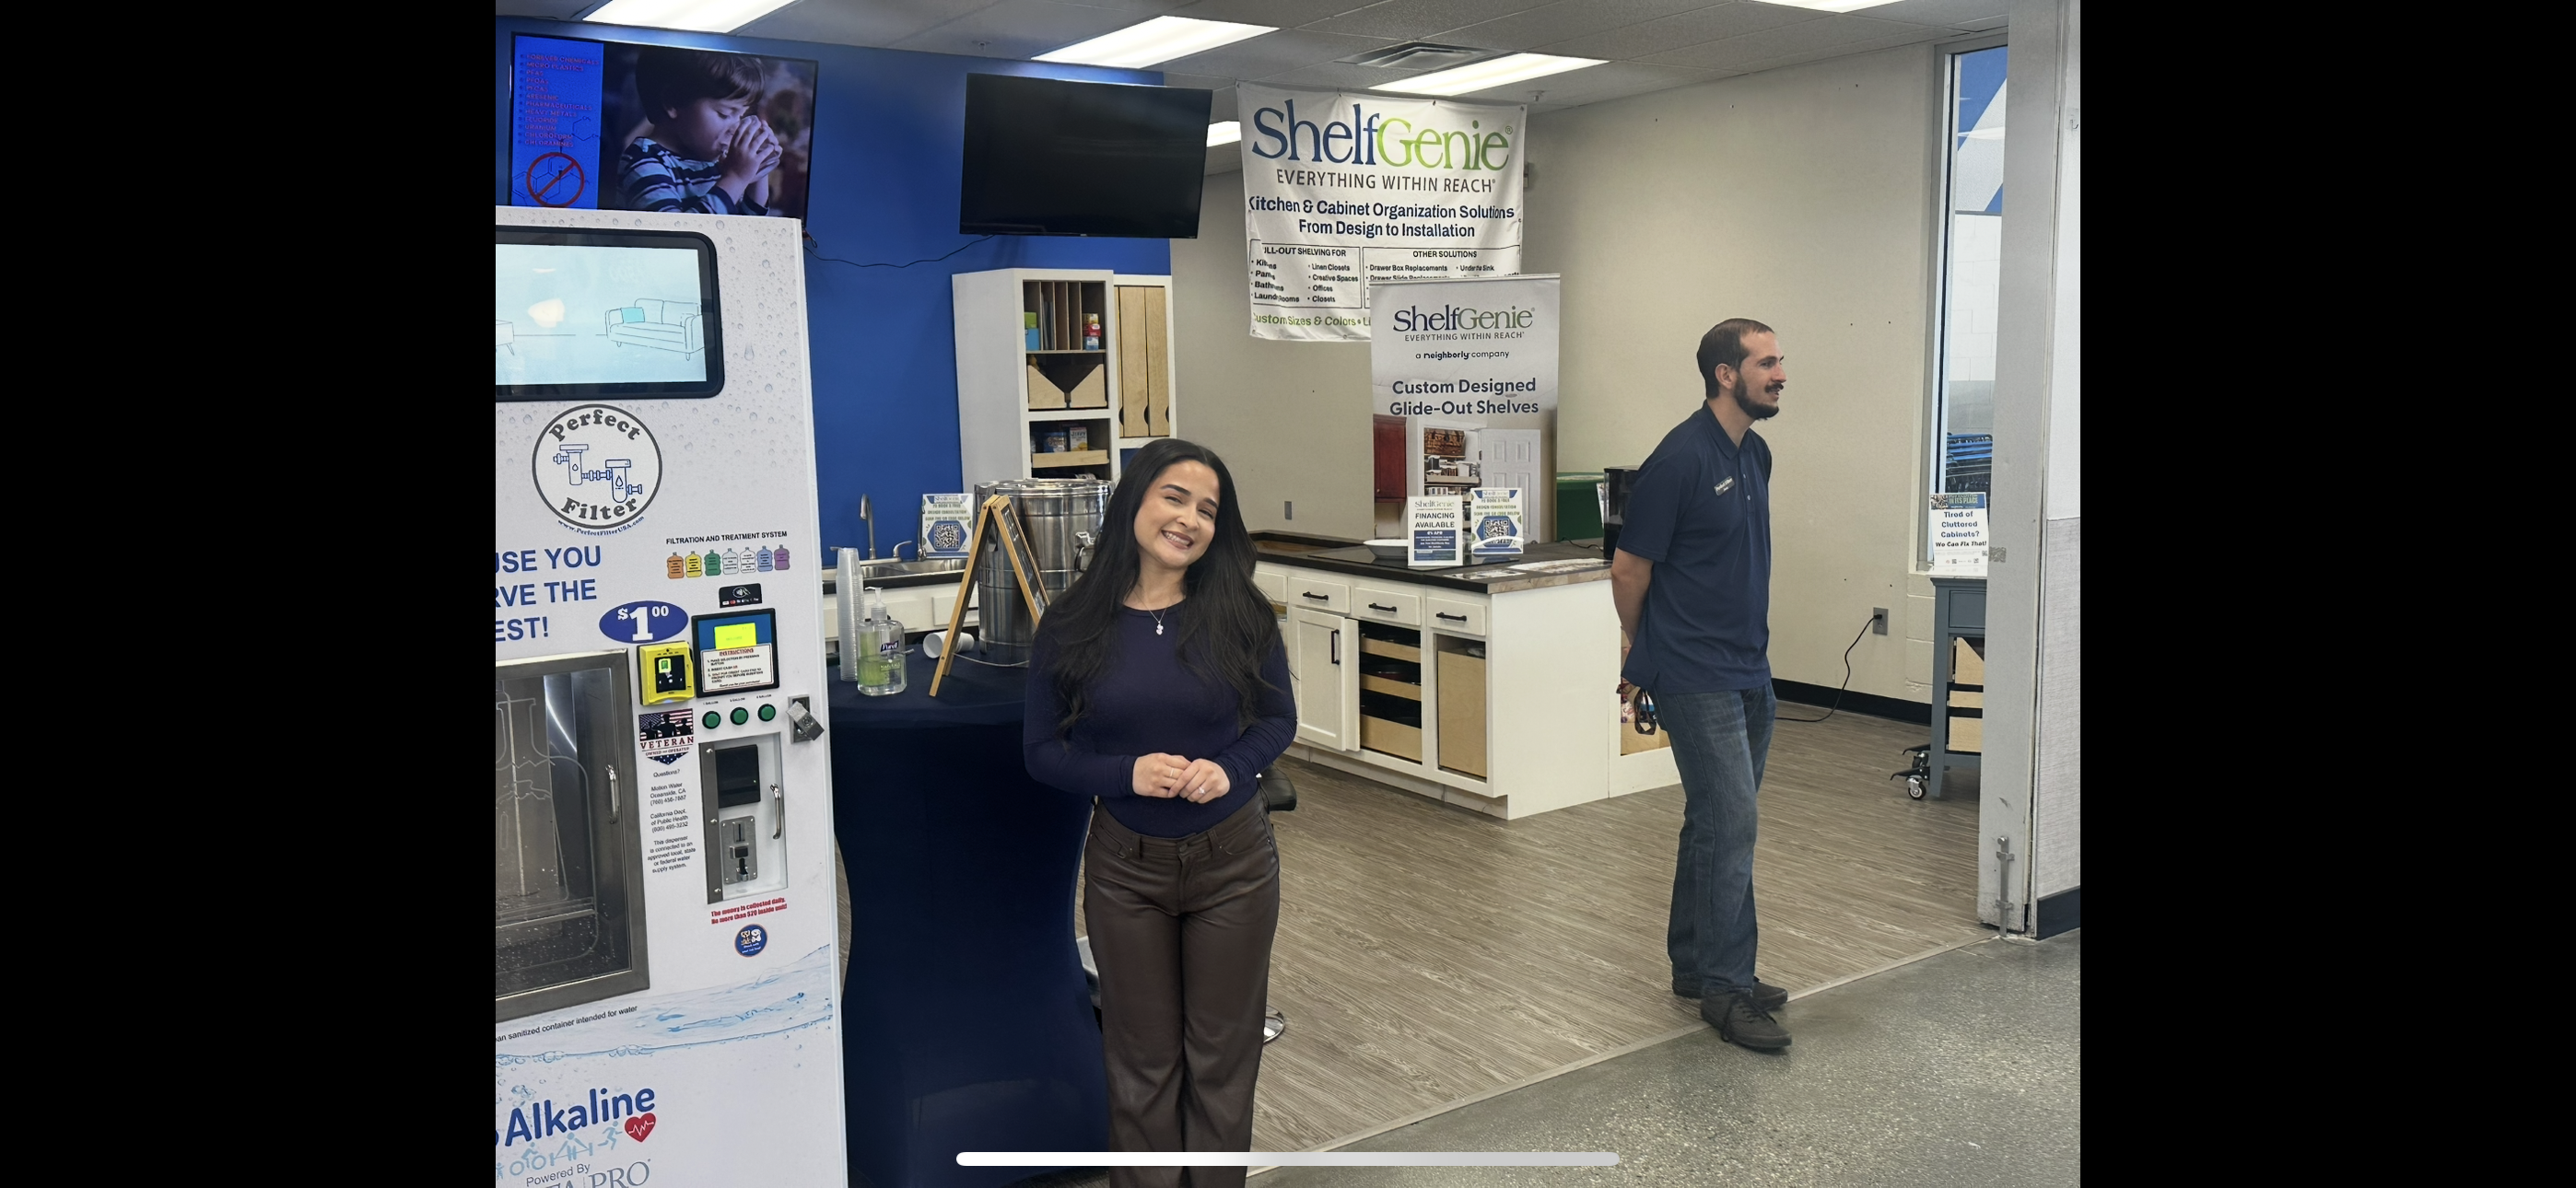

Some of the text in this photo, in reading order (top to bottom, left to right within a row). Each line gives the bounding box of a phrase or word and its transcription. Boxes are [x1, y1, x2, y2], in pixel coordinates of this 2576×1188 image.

[1251, 99, 1509, 170] ShelfGenie
[1276, 169, 1492, 193] EVERYTHING WITHIN REACH
[1303, 199, 1314, 213] &
[1317, 200, 1370, 215] Cabinet
[1373, 202, 1457, 220] Organization
[1459, 204, 1515, 219] Solutions
[1299, 219, 1475, 239] From Design to Installation
[1264, 247, 1346, 257] LL-OUT SHELVING FOR
[1328, 263, 1351, 272] Closets
[1405, 264, 1447, 273] Replacements
[1312, 295, 1336, 303] Closets
[1253, 313, 1288, 325] ustom
[1314, 316, 1322, 326] &
[1325, 316, 1357, 326] Colors
[1393, 304, 1533, 332] ShelfGenie
[1405, 332, 1458, 342] EVERYTHING
[1460, 332, 1492, 340] WITHIN
[1423, 351, 1469, 361] neighborly
[1471, 350, 1510, 359] company
[1392, 378, 1536, 396] Custom Designed
[1389, 400, 1540, 415] Glide-Out Shelves
[549, 409, 640, 442] Perfect
[561, 497, 637, 520] Filter
[557, 516, 645, 536] www.PerfectFilterUSA.com
[666, 530, 788, 544] FILTRATION AND TREATMENT SYSTEM
[496, 545, 602, 574] SE YOU
[544, 578, 597, 603] THE
[720, 648, 755, 657] INSTRUCTIONS
[640, 736, 694, 750] VETERAN
[653, 768, 680, 777] Questions?
[721, 906, 740, 914] money
[746, 899, 770, 910] collected
[757, 906, 775, 914] inside
[509, 1026, 541, 1040] sanitized
[542, 1019, 575, 1031] container
[576, 1011, 606, 1024] intended
[607, 1009, 618, 1018] for
[618, 1005, 638, 1015] water
[505, 1088, 655, 1147] Alkaline
[526, 1166, 573, 1187] Powered
[577, 1163, 591, 1174] By
[589, 1161, 650, 1188] PRO
